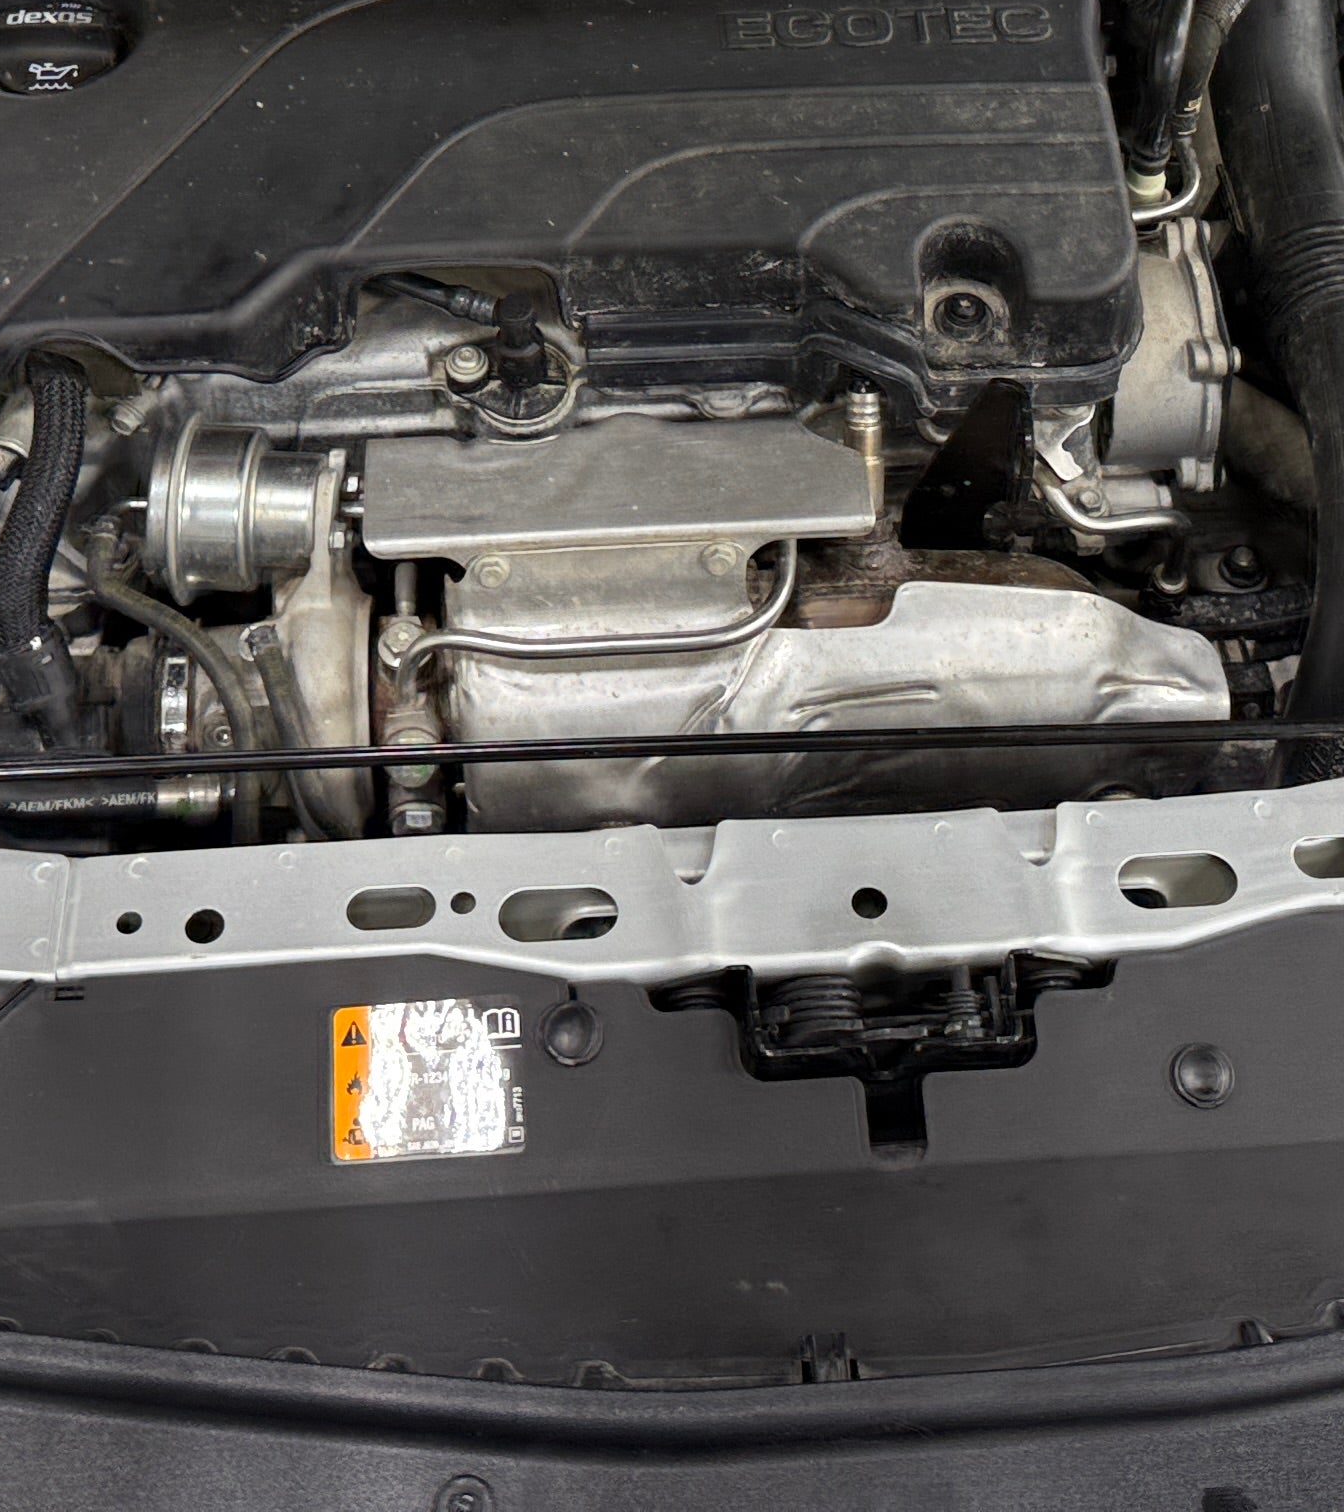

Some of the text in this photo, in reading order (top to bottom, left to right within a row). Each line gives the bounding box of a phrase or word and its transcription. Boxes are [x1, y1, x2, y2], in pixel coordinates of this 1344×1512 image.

[7, 10, 92, 25] dexos
[721, 4, 1053, 48] ECOTEC
[412, 1116, 435, 1131] PAG
